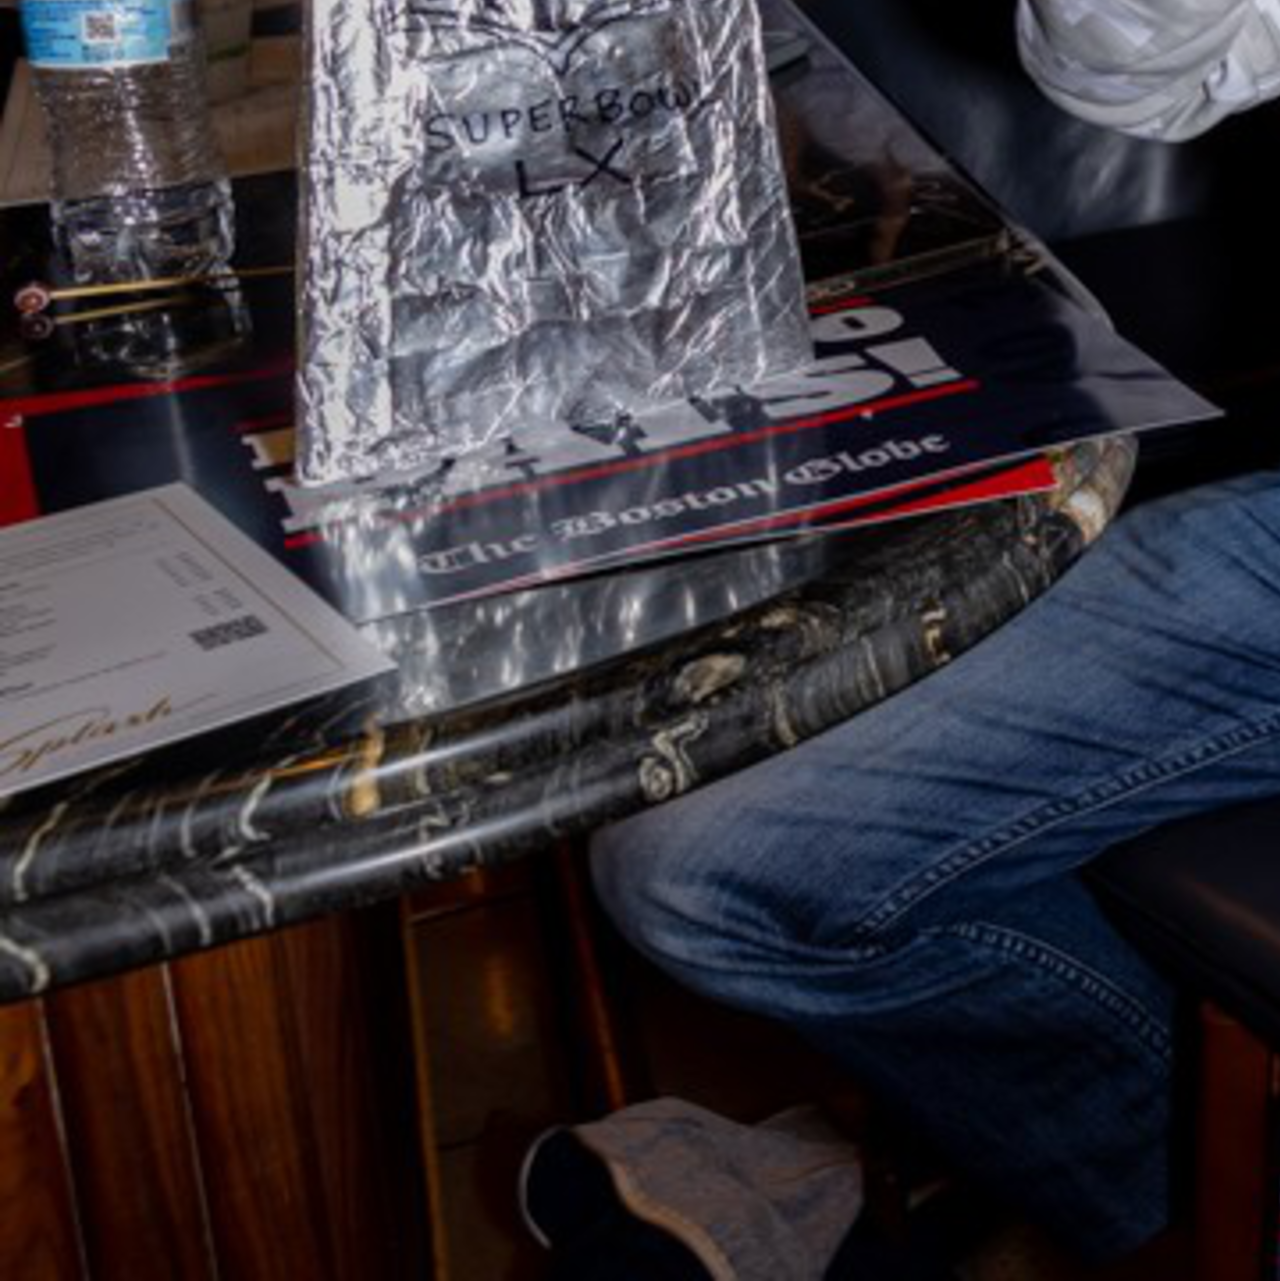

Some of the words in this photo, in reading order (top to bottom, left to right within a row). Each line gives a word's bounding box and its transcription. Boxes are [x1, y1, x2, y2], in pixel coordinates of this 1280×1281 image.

[515, 138, 632, 199] LX
[418, 532, 538, 576] The
[551, 478, 778, 539] Boston
[784, 431, 951, 486] Globe
